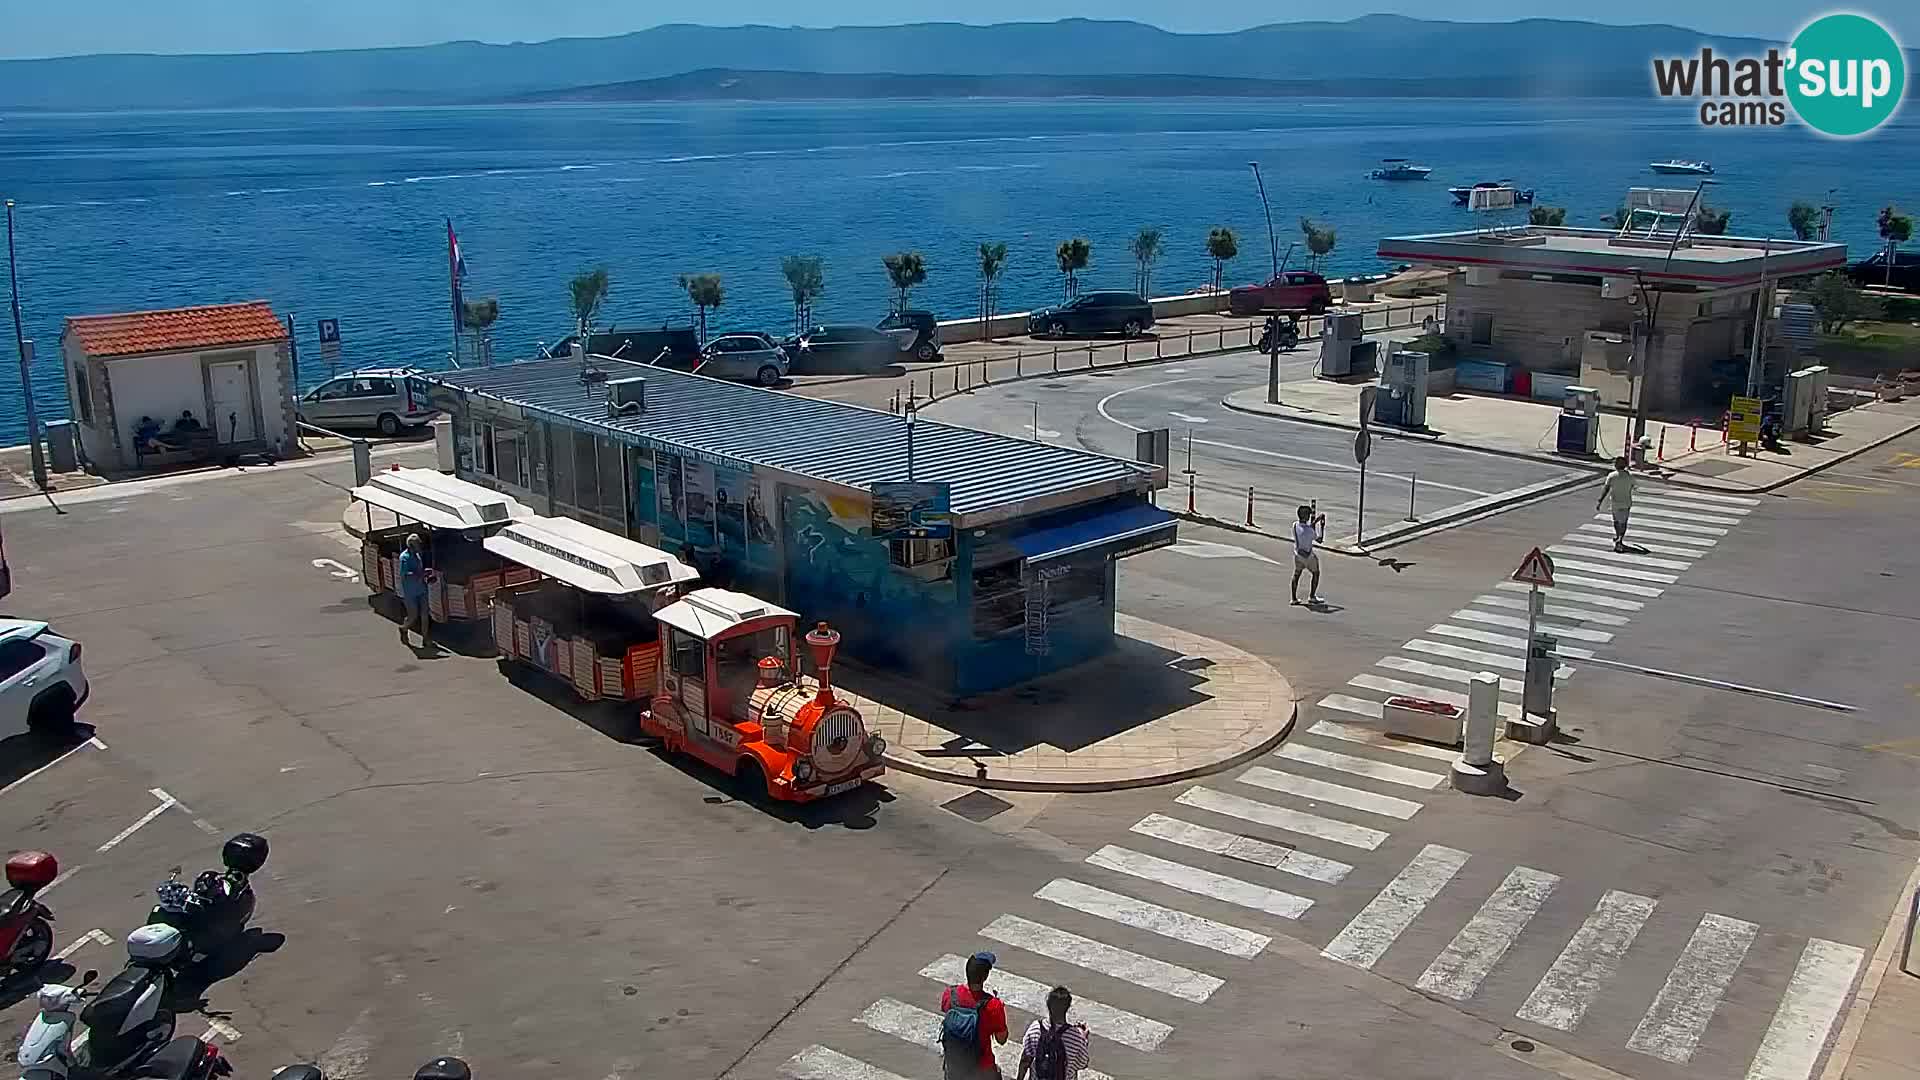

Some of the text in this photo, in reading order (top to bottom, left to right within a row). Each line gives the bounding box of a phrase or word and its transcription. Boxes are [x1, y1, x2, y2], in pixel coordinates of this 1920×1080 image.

[323, 321, 334, 339] P
[649, 439, 664, 450] BUS
[664, 443, 696, 459] STATION
[699, 451, 723, 465] TICKET
[724, 458, 750, 472] OFFICE
